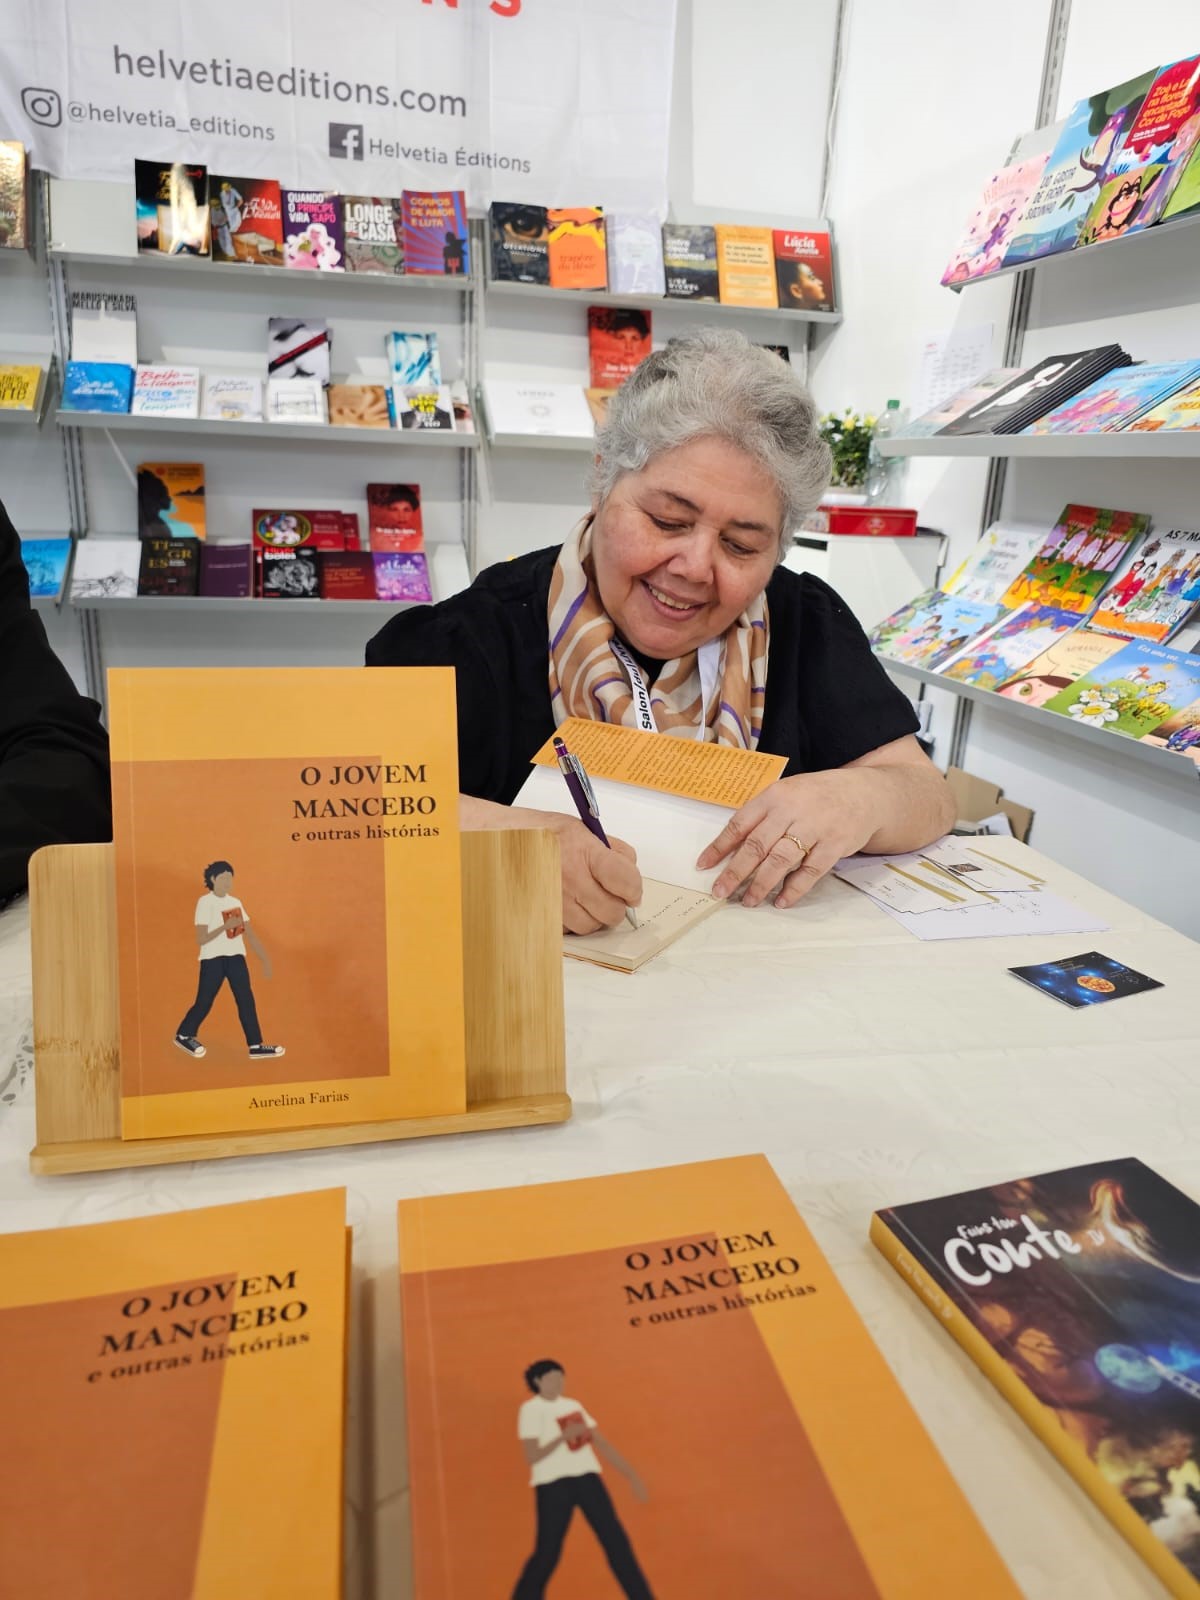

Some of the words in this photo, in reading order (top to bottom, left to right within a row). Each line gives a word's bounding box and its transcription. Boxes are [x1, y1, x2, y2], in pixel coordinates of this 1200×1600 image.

[113, 44, 467, 117] helvetiaeditions.com
[67, 101, 276, 141] @helvetia_editions
[369, 138, 448, 165] Helvetia
[455, 147, 531, 173] Éditions
[287, 192, 324, 203] QUANDO
[426, 207, 455, 217] AMOR
[288, 213, 311, 223] VIRA
[311, 213, 336, 223] SAPO
[345, 203, 393, 224] LONGE
[419, 218, 444, 228] LUTA
[358, 221, 397, 242] CASA
[301, 766, 321, 786] O
[329, 764, 427, 785] JOVEM
[292, 796, 437, 819] MANCEBO
[291, 831, 301, 842] e
[306, 828, 361, 841] outras
[366, 824, 440, 839] histórias
[248, 1094, 306, 1109] Aurelina
[309, 1090, 350, 1104] Farias
[625, 1251, 651, 1271] O
[661, 1230, 777, 1266] JOVEM
[944, 1214, 1083, 1286] Conte
[121, 1297, 152, 1318] O
[160, 1270, 299, 1312] JOVEM
[621, 1256, 800, 1305] MANCEBO
[630, 1315, 642, 1328] e
[648, 1302, 719, 1325] outras
[722, 1282, 818, 1310] histórias
[98, 1300, 309, 1357] MANCEBO
[87, 1371, 103, 1384] e
[110, 1353, 193, 1379] outras
[200, 1331, 311, 1363] histórias
